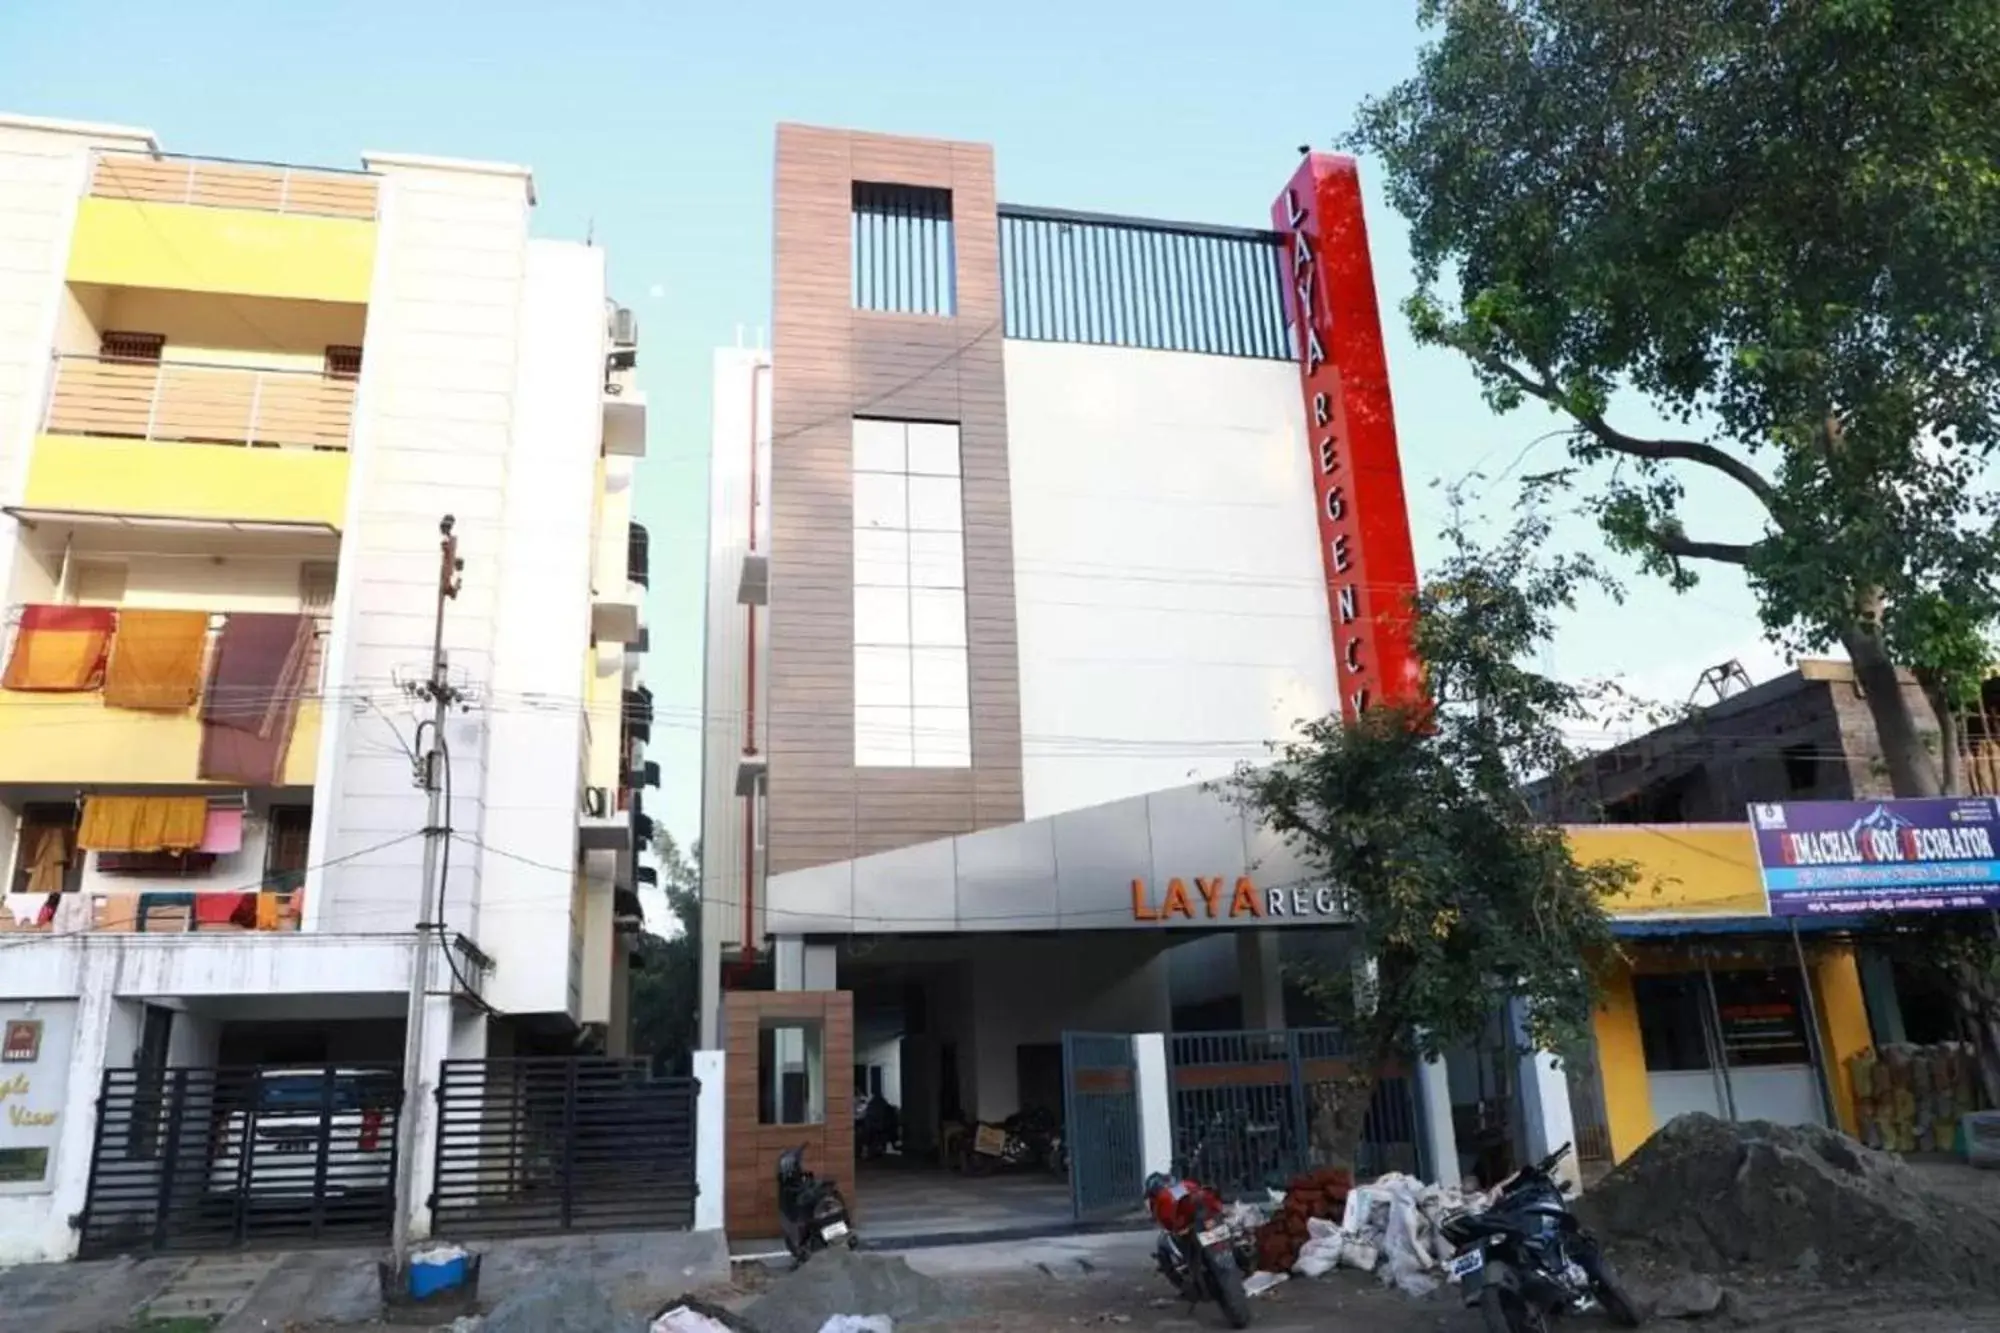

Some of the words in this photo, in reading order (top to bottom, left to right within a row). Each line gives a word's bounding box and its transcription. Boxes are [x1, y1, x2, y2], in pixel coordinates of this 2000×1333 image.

[1286, 188, 1325, 377] LAYA
[1312, 391, 1369, 723] REGENCY
[1781, 830, 1863, 865] HIMACHAL
[1900, 826, 1995, 861] DECORATOR
[1131, 875, 1262, 921] LAYA
